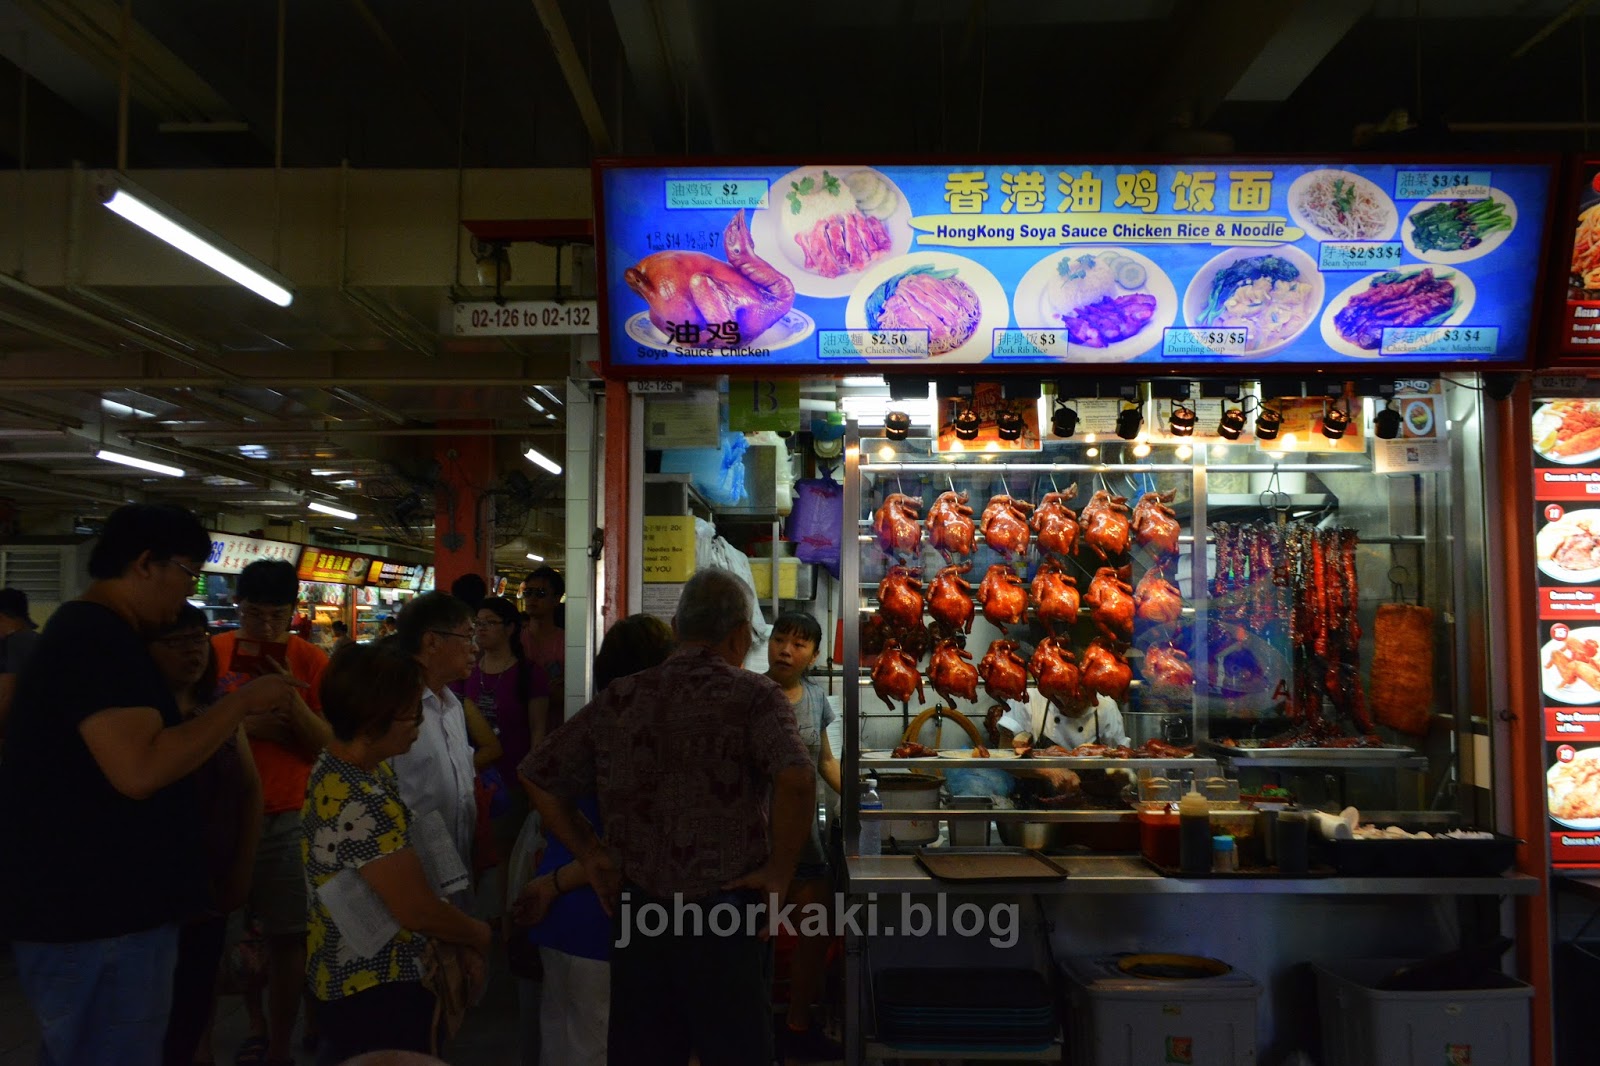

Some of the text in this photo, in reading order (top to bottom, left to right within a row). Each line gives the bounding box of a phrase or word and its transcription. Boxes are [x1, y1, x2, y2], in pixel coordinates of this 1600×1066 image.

[1432, 174, 1469, 187] $3/$4
[671, 183, 738, 197] 油鸡饭 $2
[943, 170, 1274, 213] 香港油鸡饭面
[1450, 186, 1487, 198] Vegetable
[671, 197, 765, 208] Soya Sauce Chicken Rice
[937, 223, 1285, 241] HongKong Soya Sauce Chicken Rice & Noodle
[666, 232, 681, 249] $14
[709, 232, 720, 248] $7
[1322, 259, 1367, 269] Bean Sprout
[472, 307, 590, 328] 02-126 to 02-132
[665, 320, 741, 345] 油鸡
[998, 332, 1056, 346] 排骨饭 $3
[1168, 331, 1245, 344] 水饺汤 $3/$5
[1443, 330, 1480, 342] $3/$4
[871, 333, 908, 346] $2.50
[637, 345, 770, 360] Soya Sauce Chicken
[823, 346, 840, 356] Soya
[842, 346, 863, 354] Sauce
[865, 345, 896, 354] Chicken
[998, 346, 1048, 354] Pork Rib Rice
[1168, 344, 1226, 355] Dumpling Soup
[637, 380, 673, 391] 02-126
[753, 380, 778, 412] B
[655, 565, 672, 573] YOU
